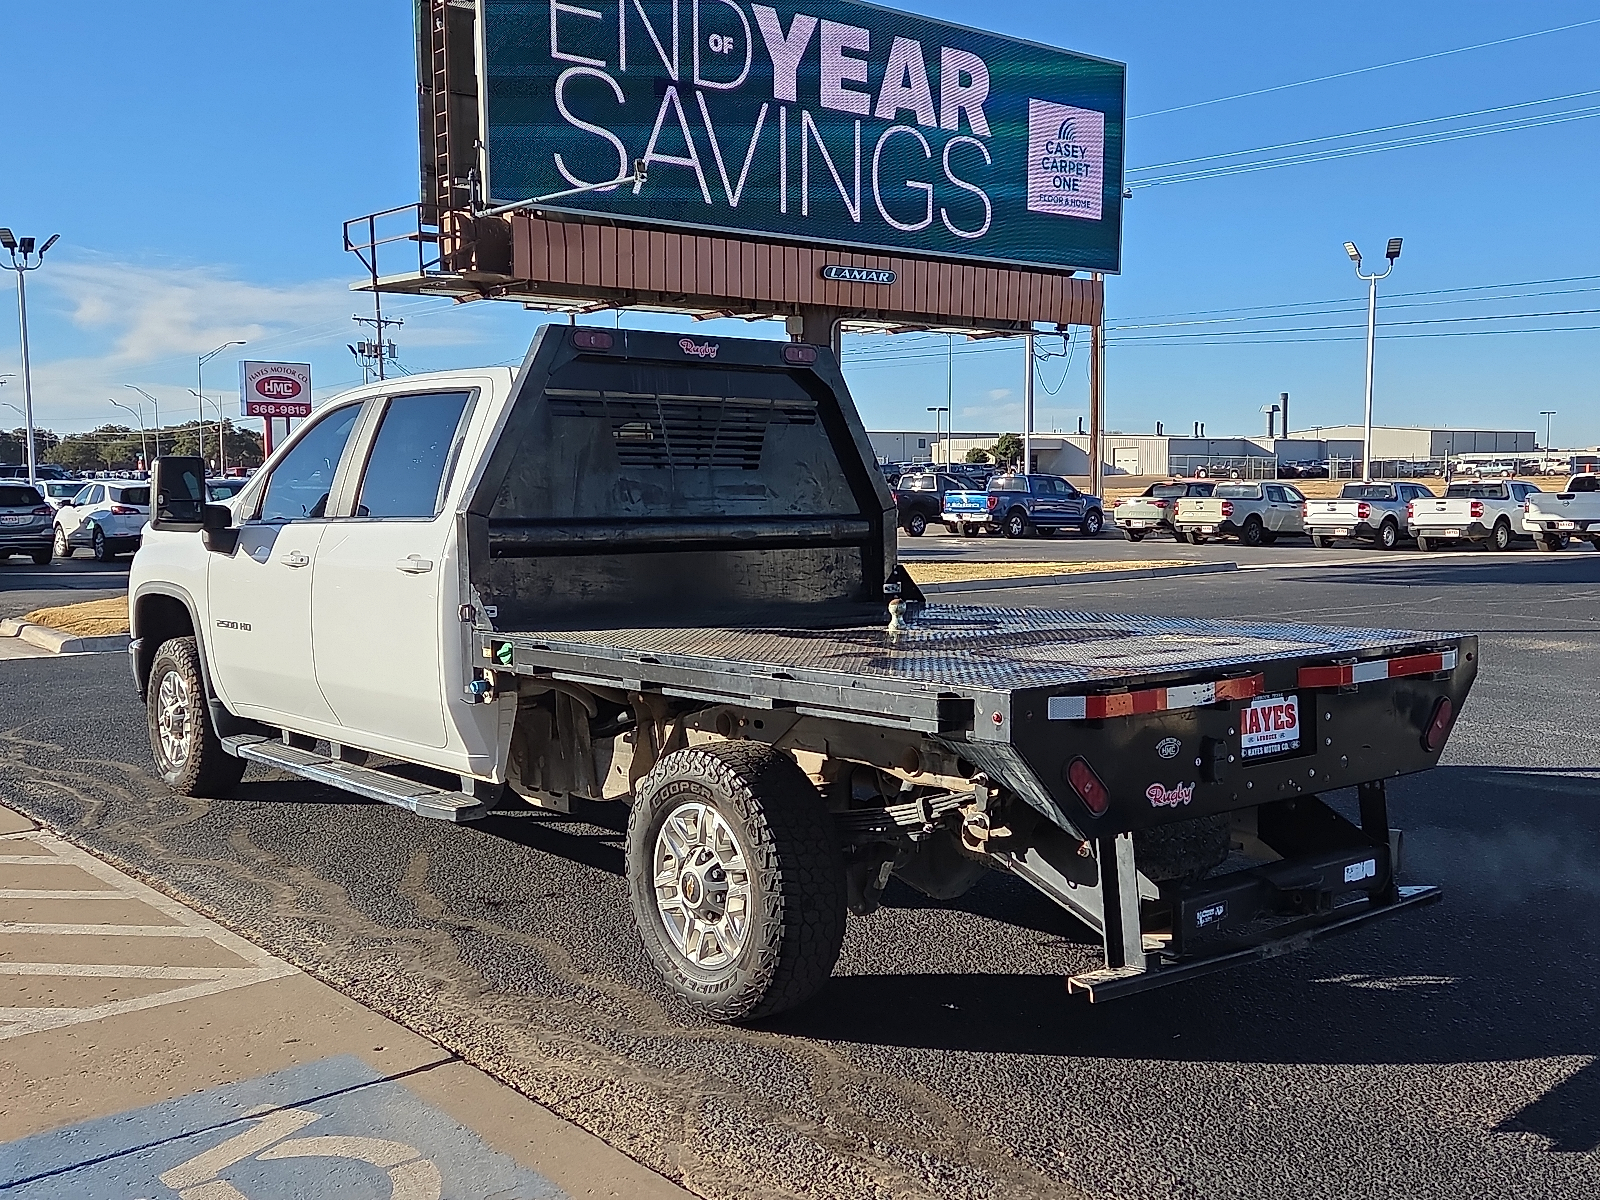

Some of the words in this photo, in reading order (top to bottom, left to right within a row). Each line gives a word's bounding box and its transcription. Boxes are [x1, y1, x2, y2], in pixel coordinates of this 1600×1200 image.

[551, 0, 752, 89] END
[709, 33, 734, 54] OF
[751, 3, 992, 138] YEAR
[553, 66, 992, 239] SAVINGS
[1045, 140, 1088, 160] CASEY
[1041, 157, 1091, 177] CARPET
[1052, 175, 1080, 191] ONE
[1039, 193, 1063, 205] FLOOR
[1070, 199, 1091, 209] HOME
[830, 267, 890, 282] LAMAR
[678, 338, 720, 358] Rugby
[248, 367, 269, 382] HAYES
[270, 366, 297, 377] MOTOR
[264, 379, 293, 396] HMC
[252, 404, 307, 415] 368-9815
[216, 619, 239, 630] 2500
[240, 622, 252, 632] HD
[652, 781, 714, 809] COOPER
[1145, 782, 1196, 808] Rugby
[674, 970, 738, 994] COOPER
